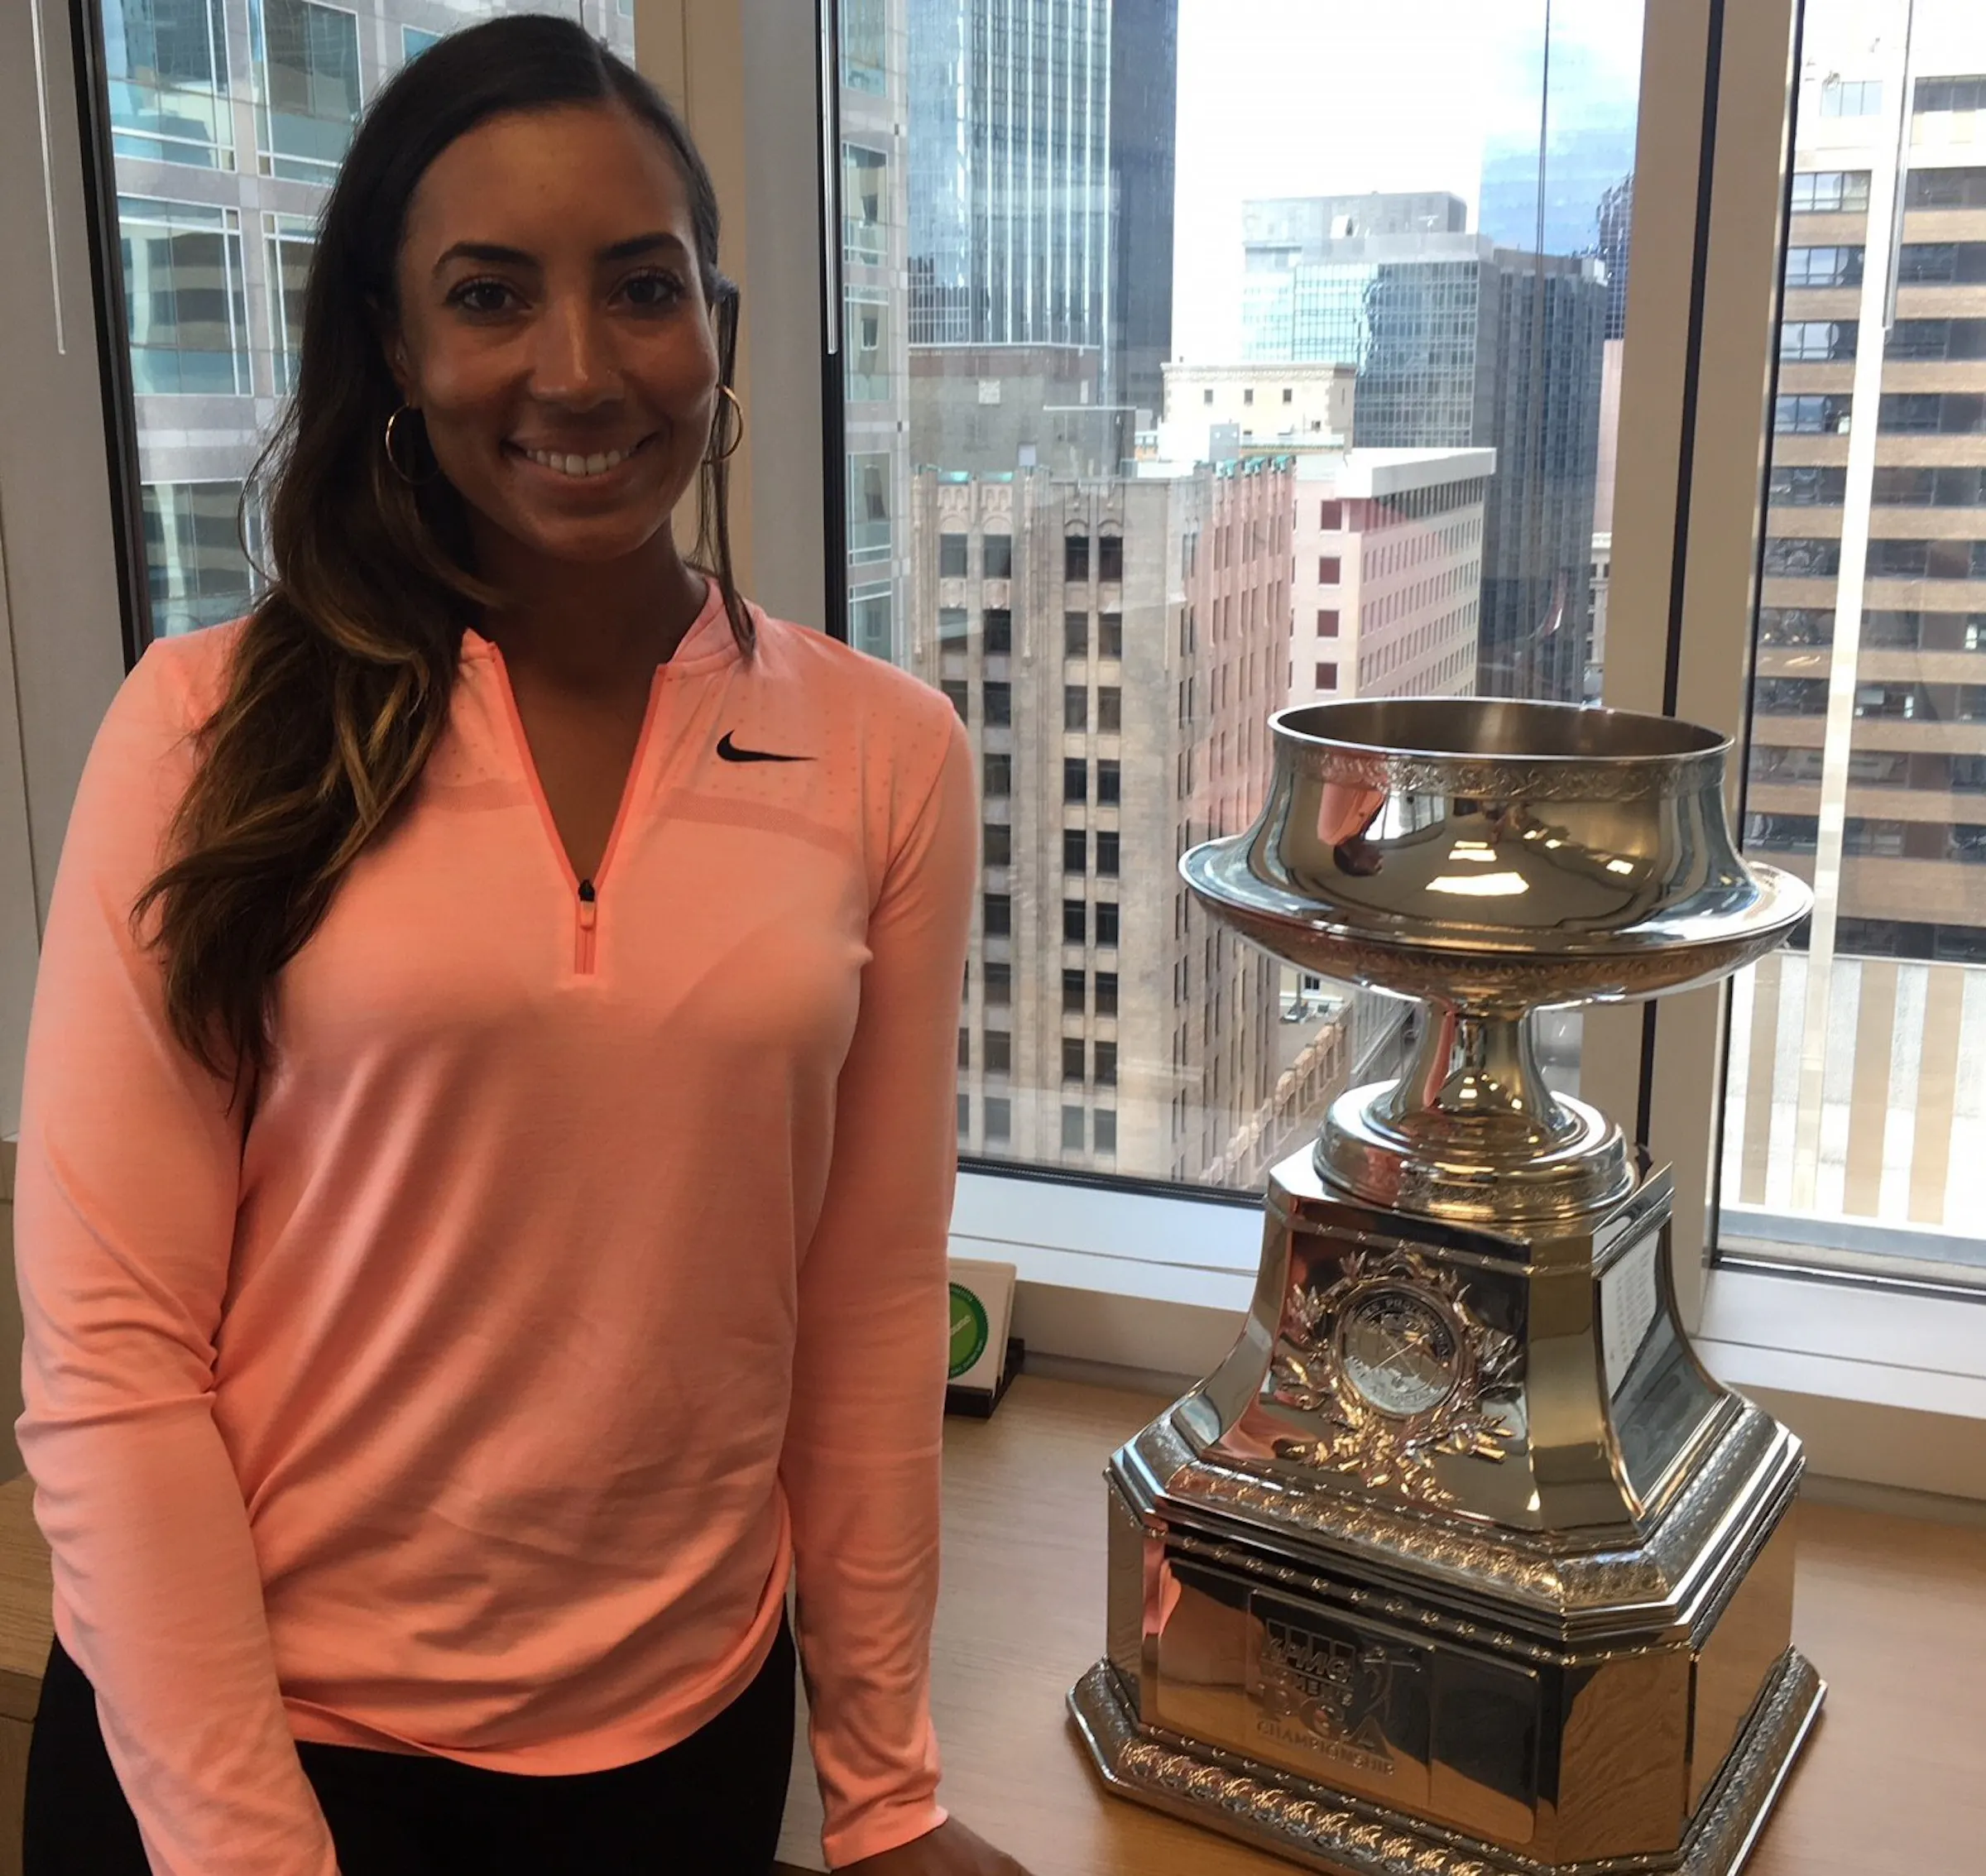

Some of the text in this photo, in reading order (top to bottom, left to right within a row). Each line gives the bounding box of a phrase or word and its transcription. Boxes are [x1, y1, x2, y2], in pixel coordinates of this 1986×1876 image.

[1260, 1638, 1355, 1682] KPMG
[1256, 1682, 1394, 1760] PGA
[1257, 1720, 1395, 1775] CHAMPIONSHIP
